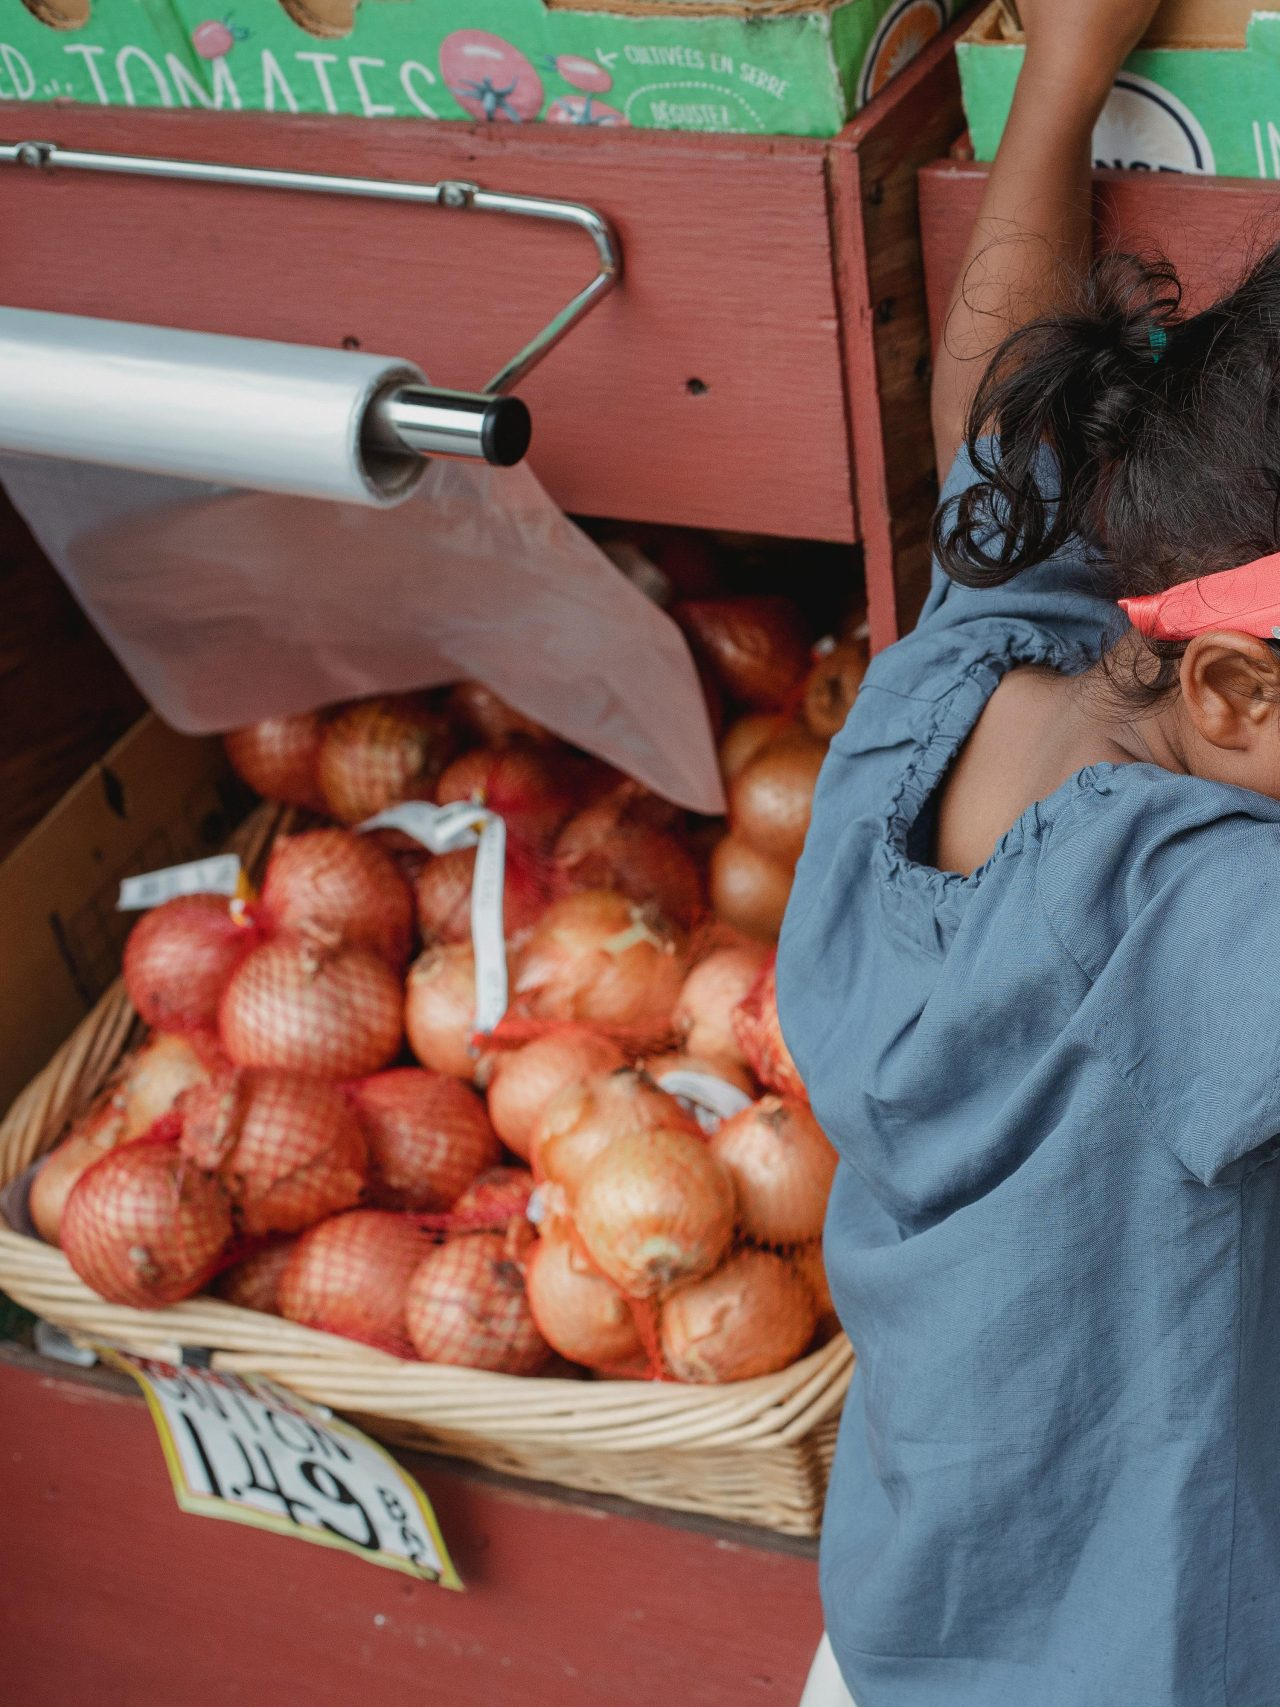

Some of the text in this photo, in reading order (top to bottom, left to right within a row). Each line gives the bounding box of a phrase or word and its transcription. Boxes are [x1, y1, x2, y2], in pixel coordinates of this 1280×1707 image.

[709, 52, 734, 75] EN
[739, 62, 790, 100] SERRE
[179, 1410, 381, 1552] 1.49
